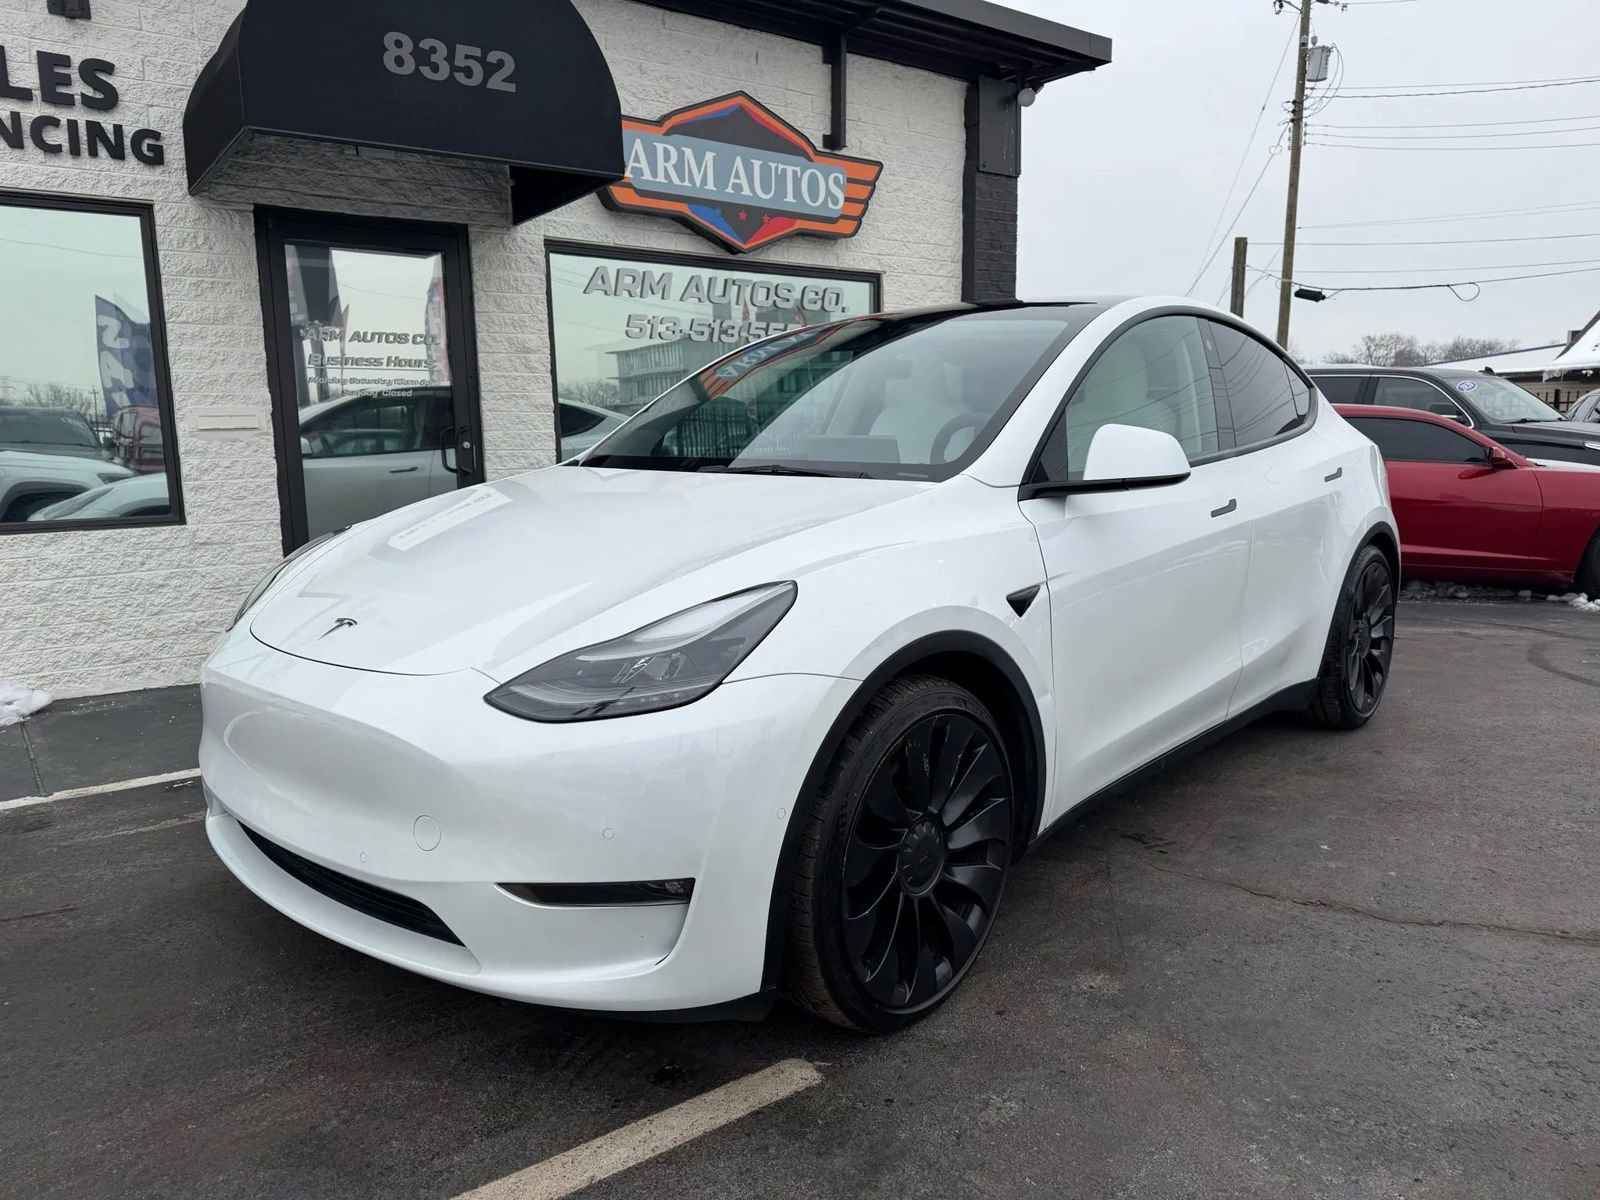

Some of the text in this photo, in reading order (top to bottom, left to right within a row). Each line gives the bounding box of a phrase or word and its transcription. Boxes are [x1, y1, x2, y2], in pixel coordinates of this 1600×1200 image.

[0, 45, 119, 111] LES
[383, 31, 516, 93] 8352
[624, 138, 845, 210] ARM AUTOS
[583, 265, 673, 300] ARM
[679, 274, 796, 311] AUTOS
[304, 328, 344, 342] ARM
[349, 330, 410, 345] AUTOS
[308, 354, 384, 368] Business
[382, 388, 413, 397] Closed
